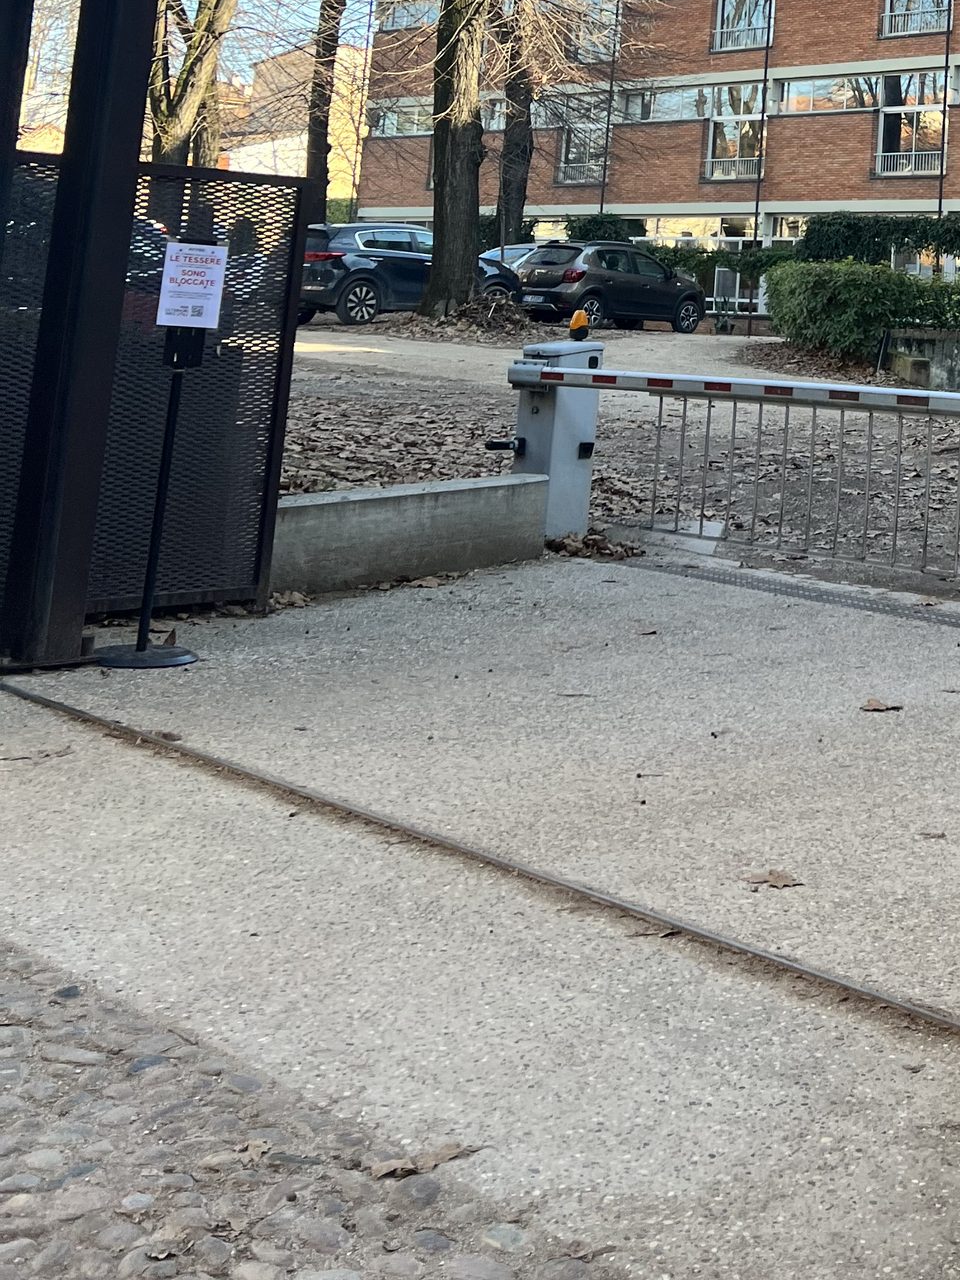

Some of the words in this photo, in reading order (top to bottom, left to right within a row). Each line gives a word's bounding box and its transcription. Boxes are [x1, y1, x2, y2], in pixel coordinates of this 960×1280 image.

[170, 255, 180, 263] LE
[183, 255, 222, 266] TESSERE
[169, 277, 216, 287] BLOCCATE
